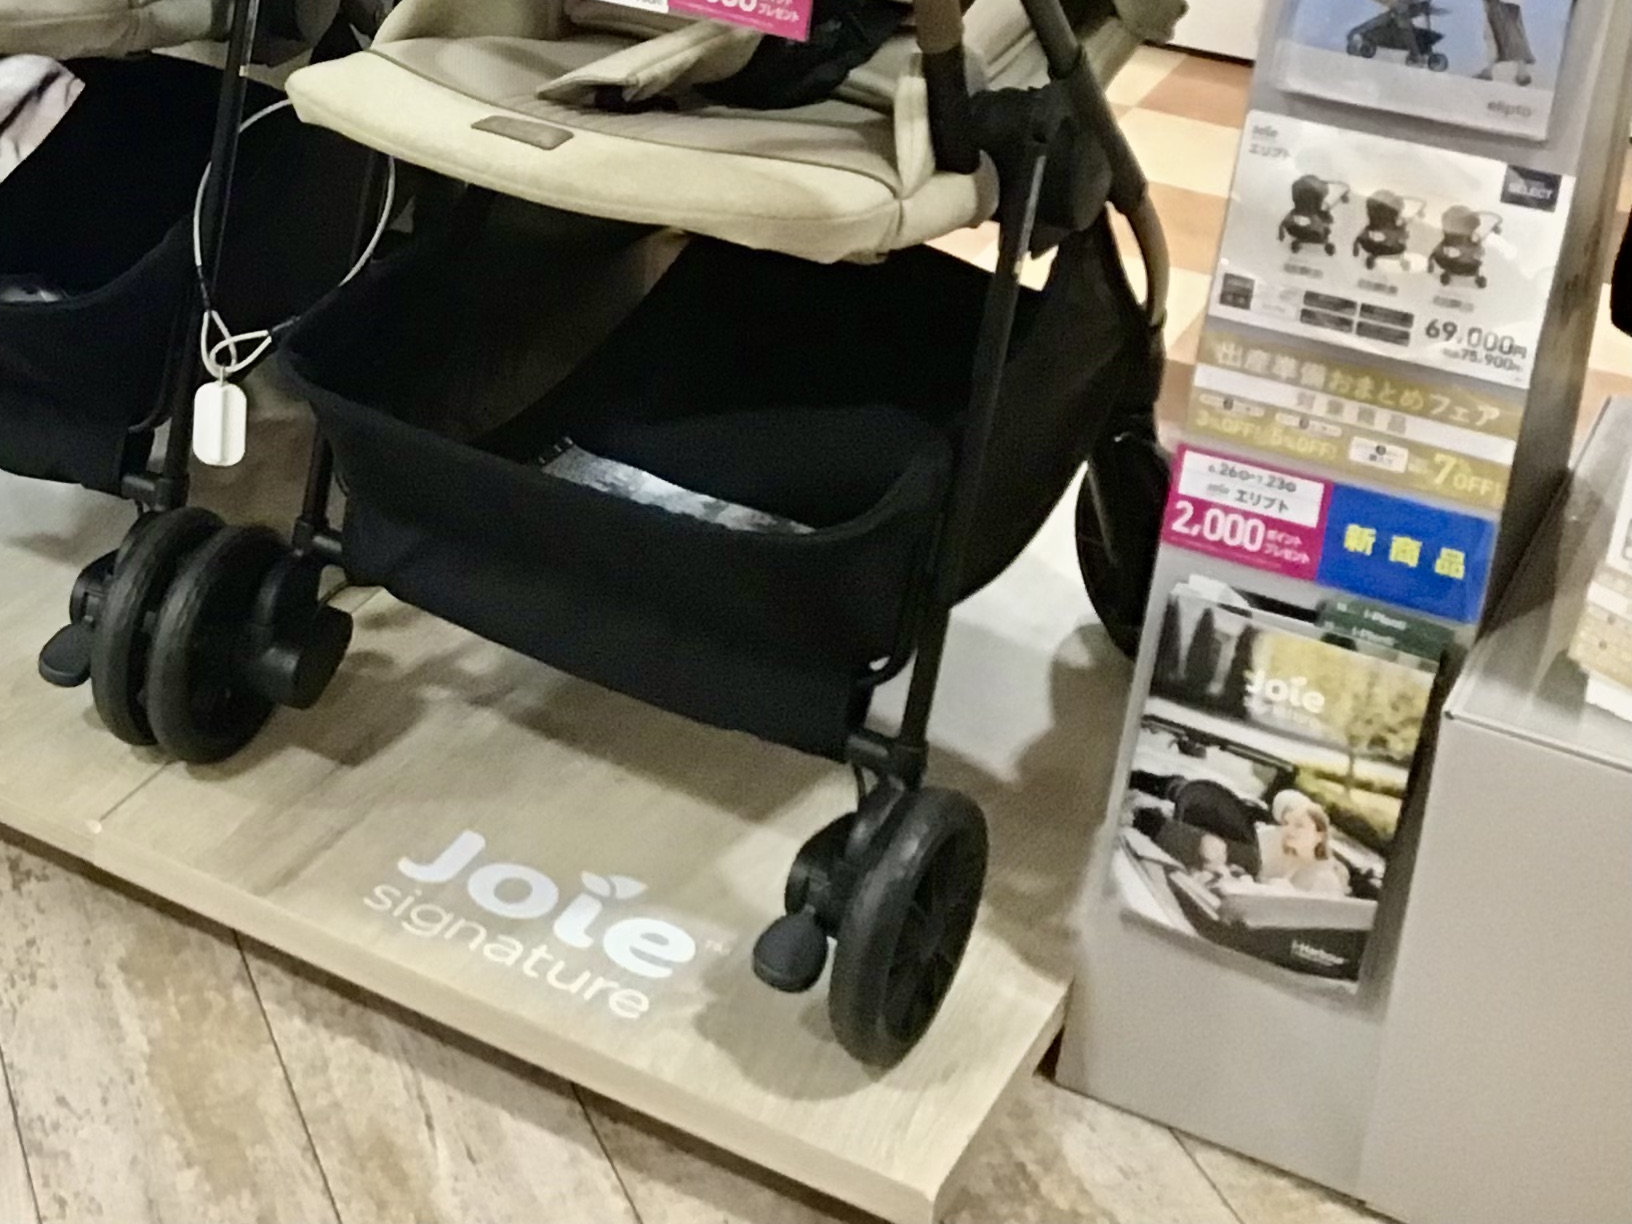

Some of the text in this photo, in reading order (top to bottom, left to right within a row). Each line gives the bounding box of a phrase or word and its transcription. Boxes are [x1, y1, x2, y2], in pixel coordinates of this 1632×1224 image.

[1425, 317, 1528, 359] 69,000円
[1172, 500, 1266, 553] 2,000
[1244, 669, 1326, 714] Joie
[398, 829, 696, 979] Joie
[363, 883, 650, 1020] signature
